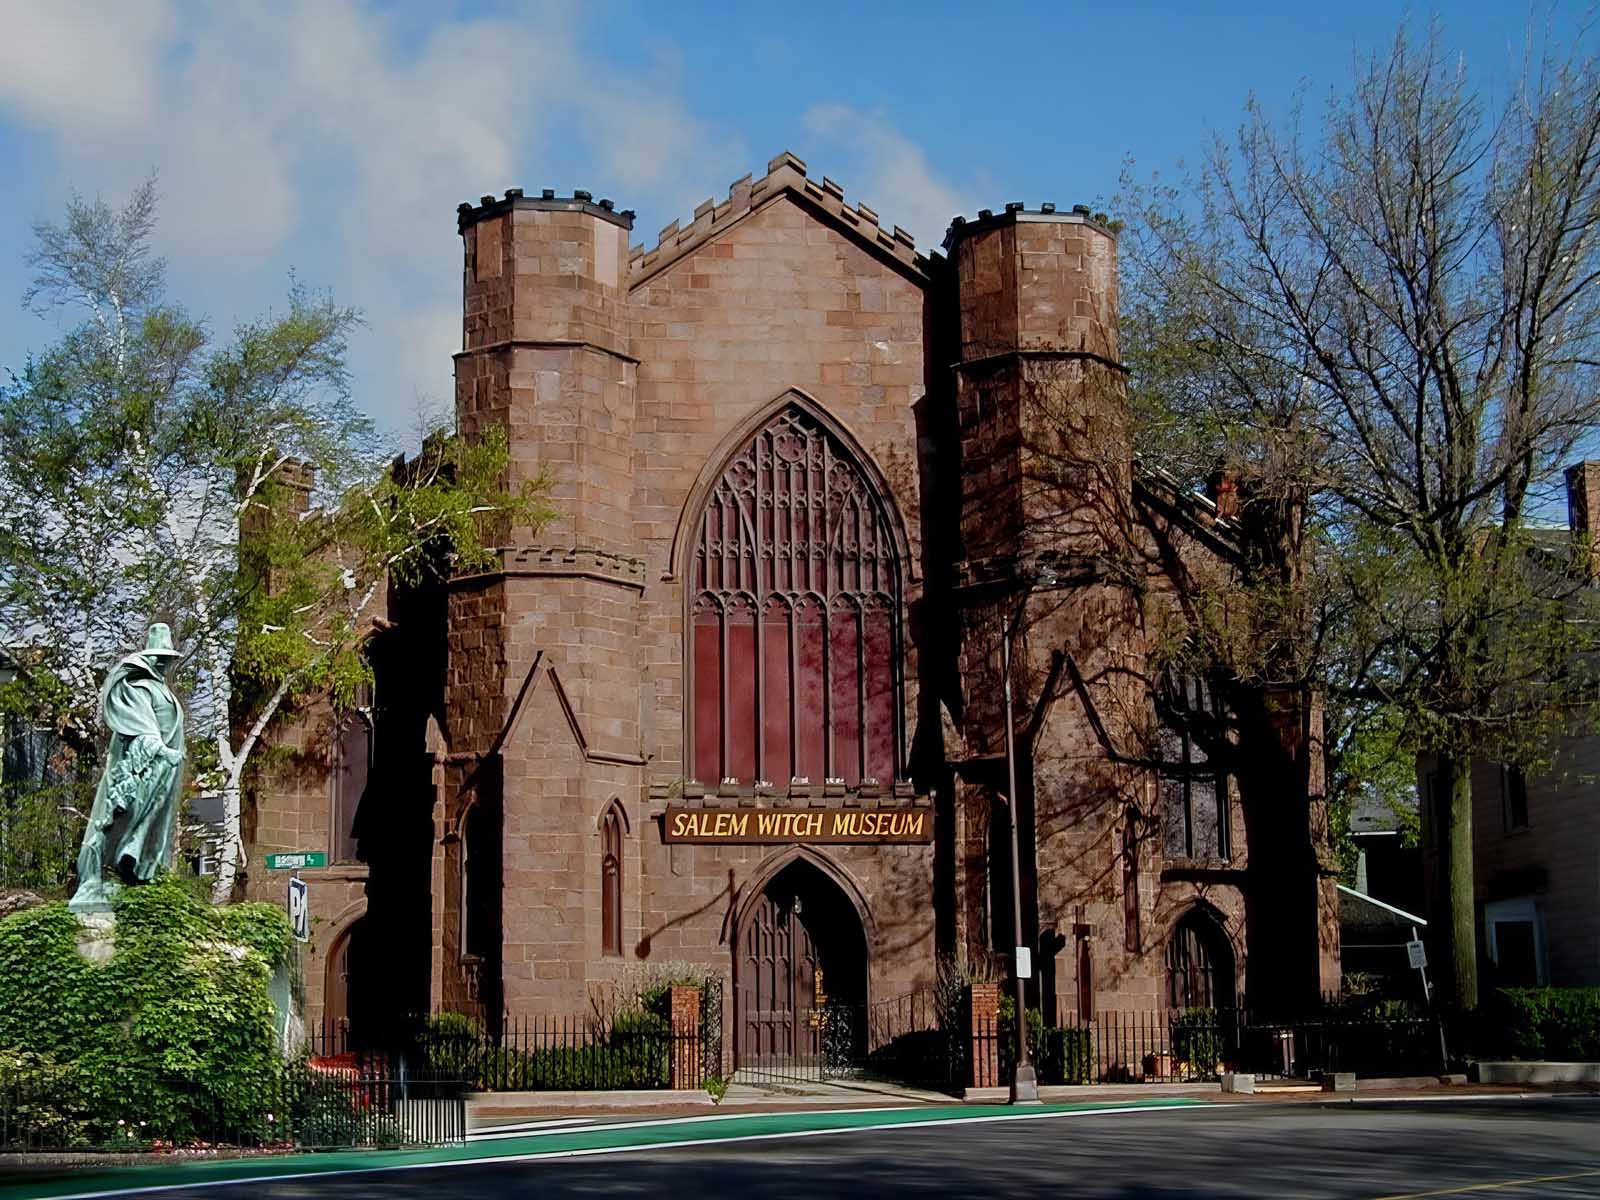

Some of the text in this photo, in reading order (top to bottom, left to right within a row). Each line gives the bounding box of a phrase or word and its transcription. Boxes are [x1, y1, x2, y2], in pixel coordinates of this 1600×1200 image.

[671, 812, 924, 836] SALEM WITCH MUSEUM
